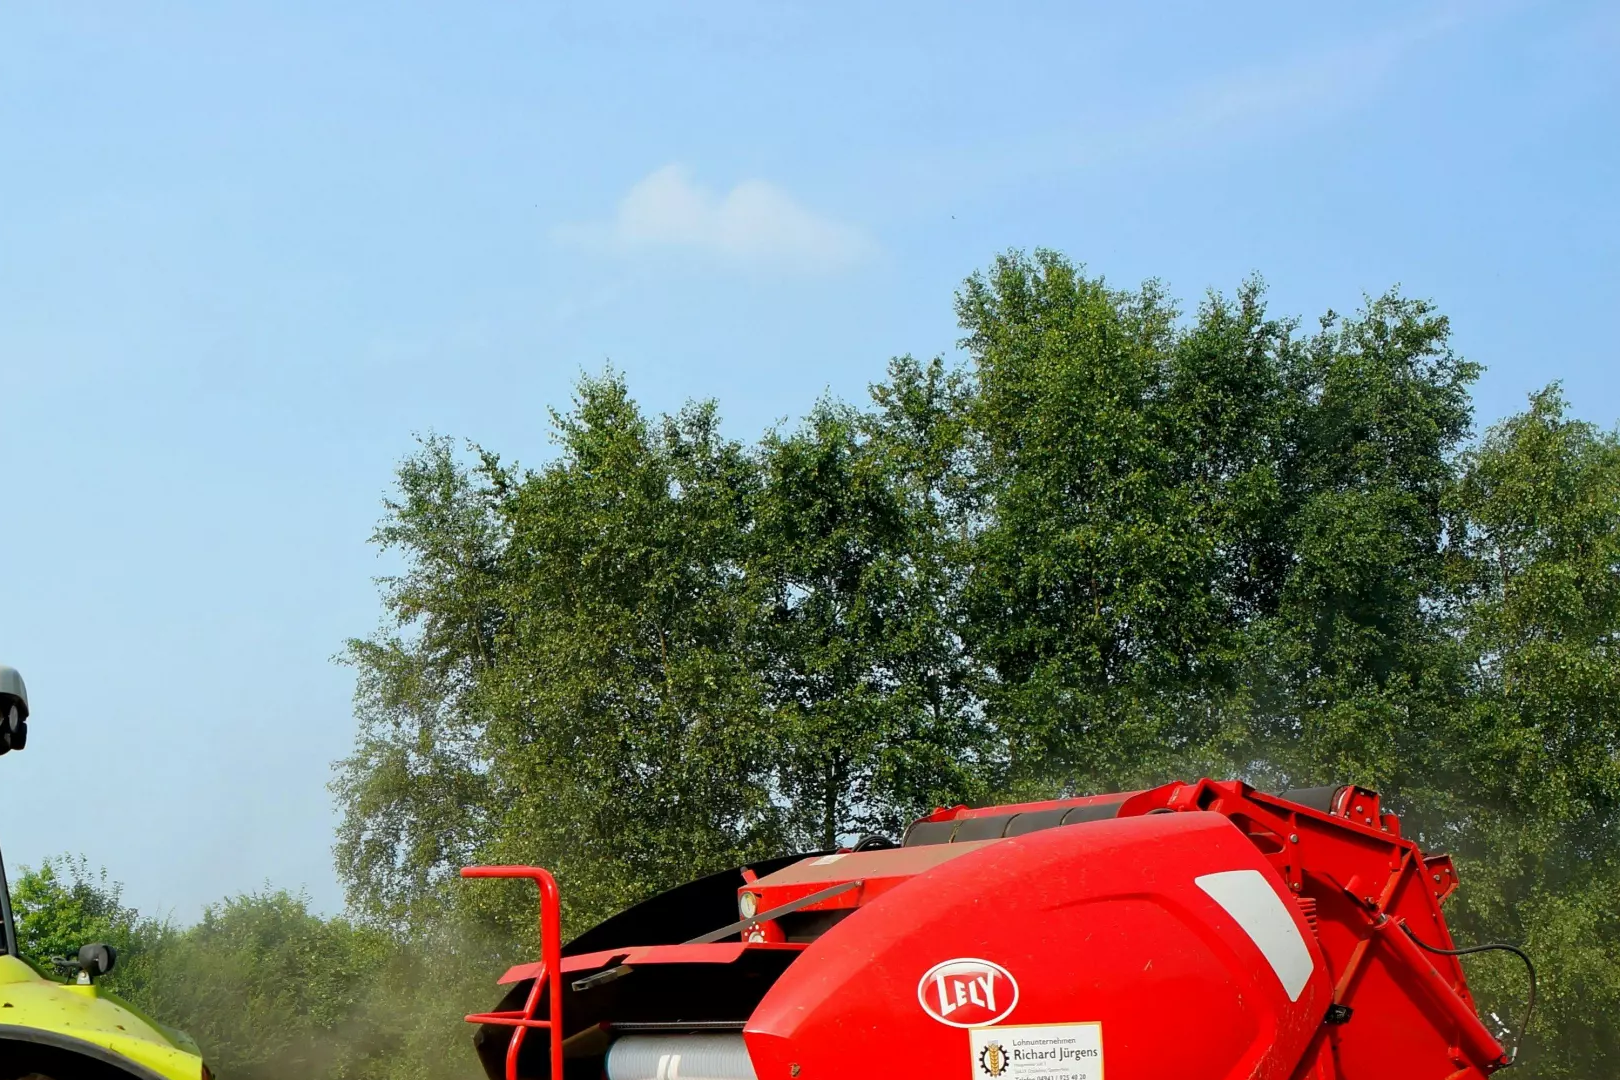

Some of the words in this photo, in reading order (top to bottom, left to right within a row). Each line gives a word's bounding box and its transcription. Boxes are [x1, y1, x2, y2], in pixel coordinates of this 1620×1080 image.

[936, 970, 996, 1017] LELY
[1012, 1037, 1076, 1046] Lohnunternehmen
[1014, 1049, 1056, 1060] Richard
[1059, 1047, 1098, 1062] Jürgens
